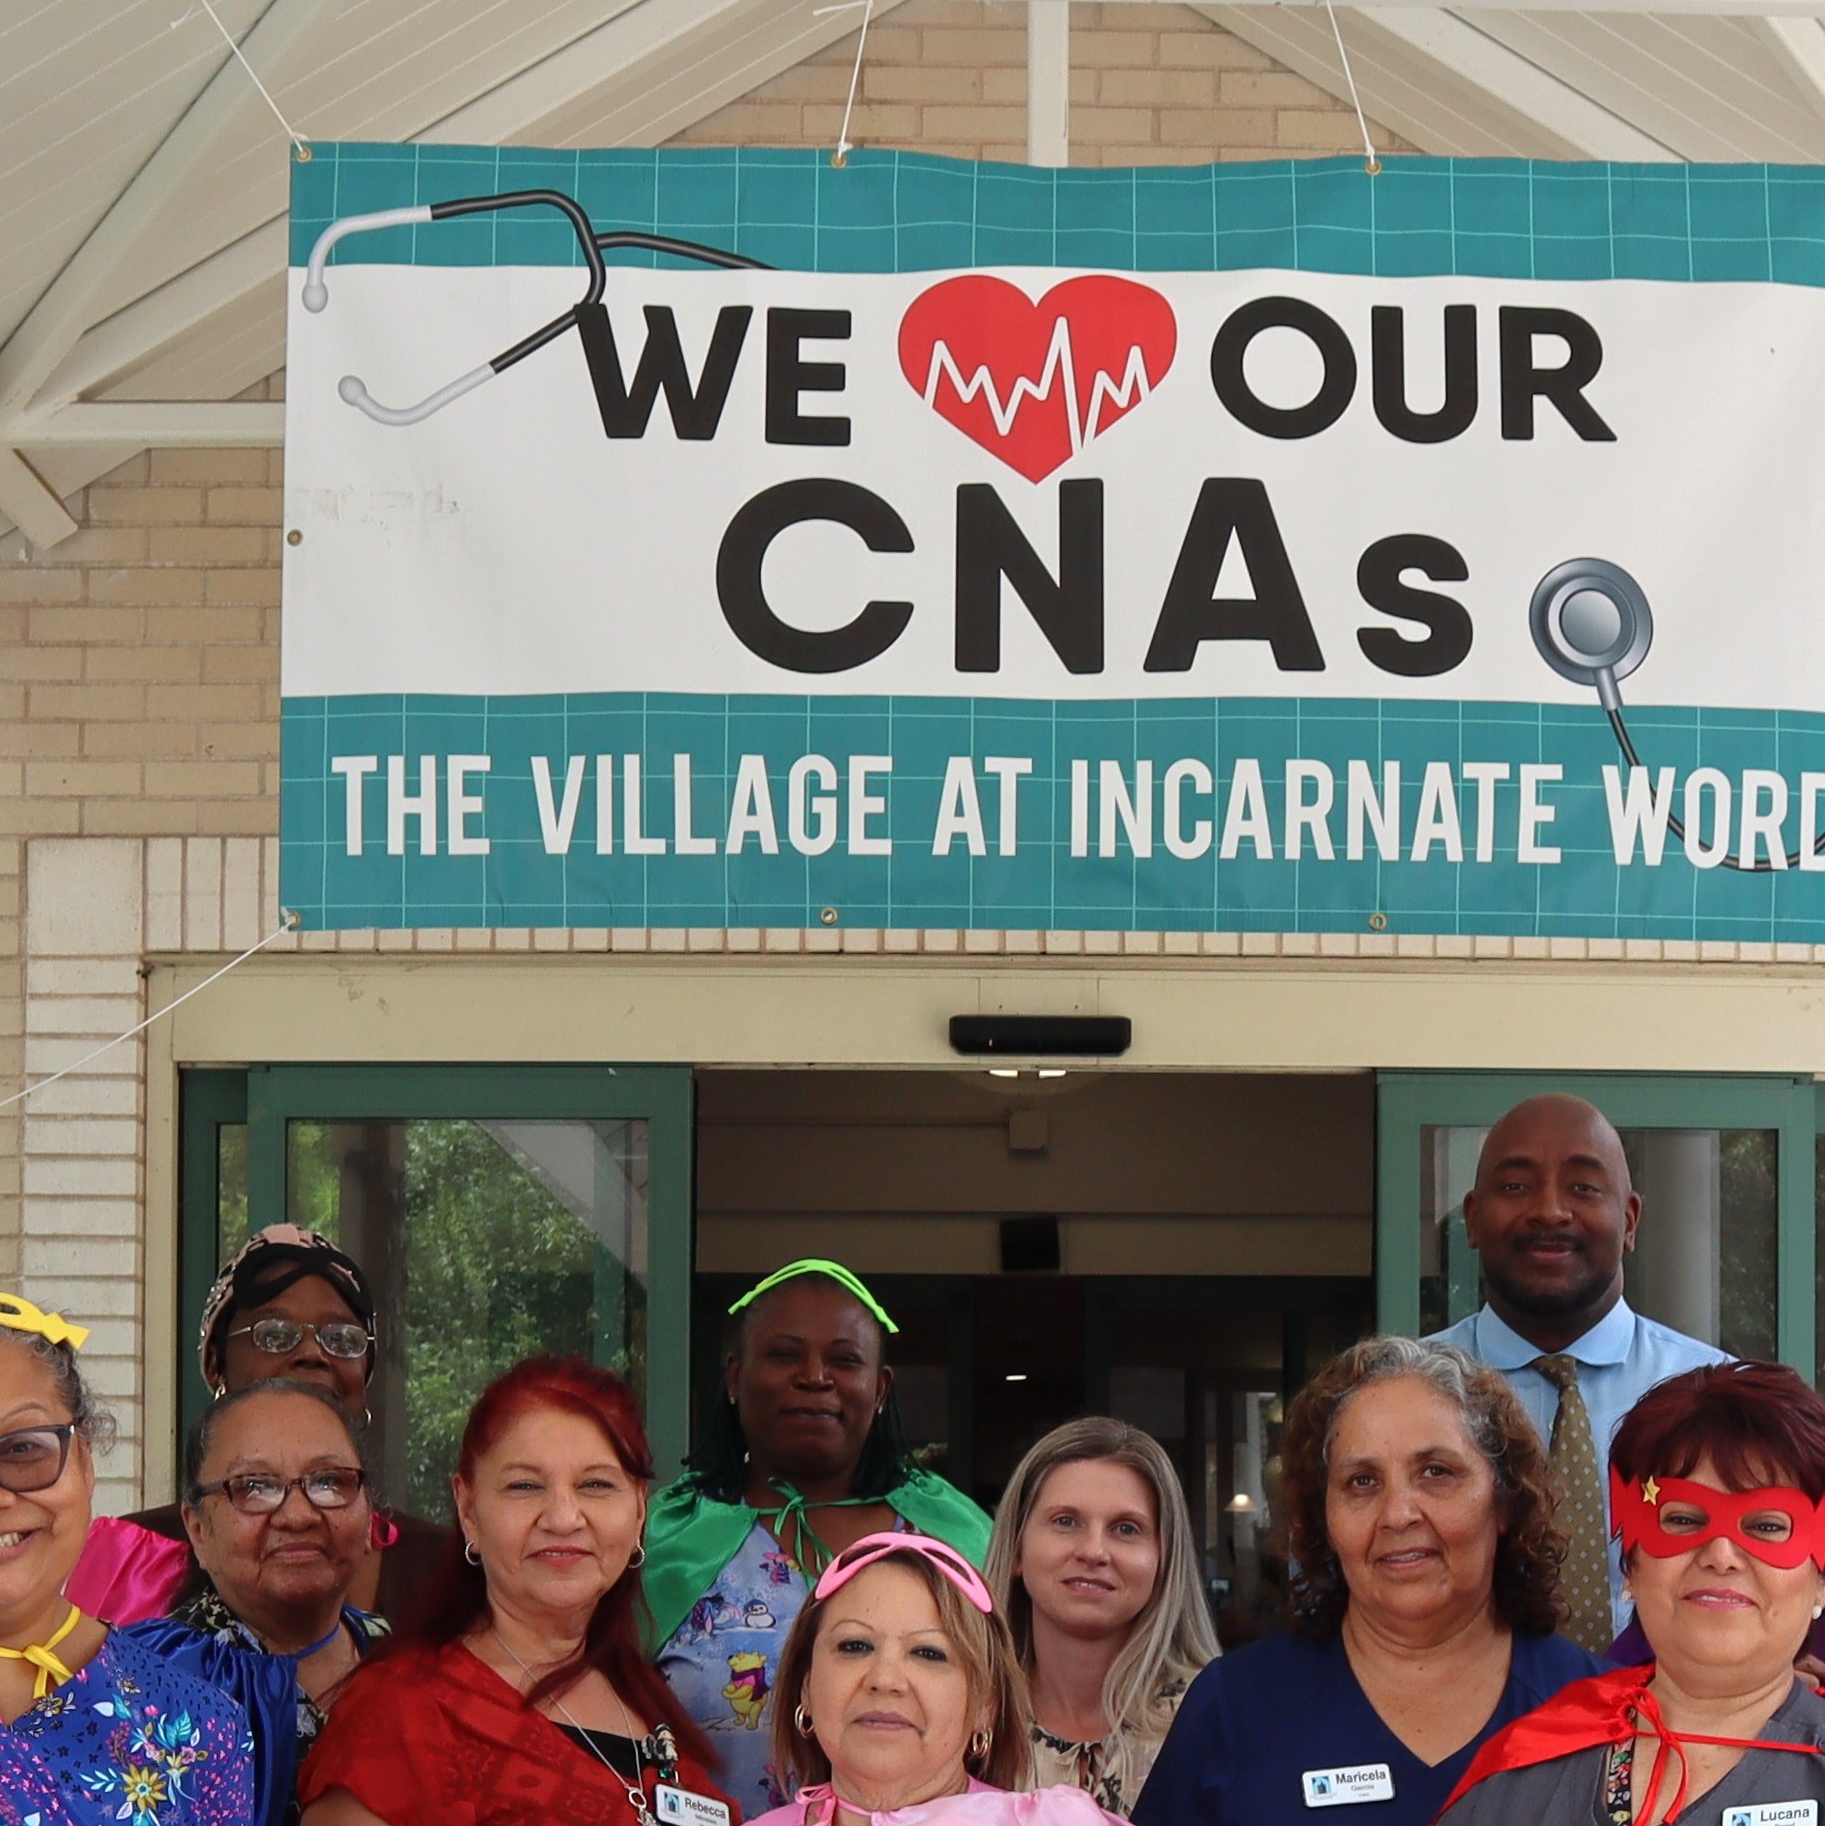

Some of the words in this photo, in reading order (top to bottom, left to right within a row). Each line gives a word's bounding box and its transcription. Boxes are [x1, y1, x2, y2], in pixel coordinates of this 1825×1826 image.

[576, 303, 853, 446] WE
[1210, 294, 1617, 445] OUR
[715, 477, 1473, 678] CNAs
[330, 754, 492, 858] THE
[531, 753, 893, 859] VILLAGE
[931, 757, 1034, 861] AT
[1070, 759, 1563, 868] INCARNATE
[684, 1796, 727, 1820] Rebecca
[1335, 1769, 1387, 1785] Maricela
[1760, 1808, 1810, 1822] Lucana
